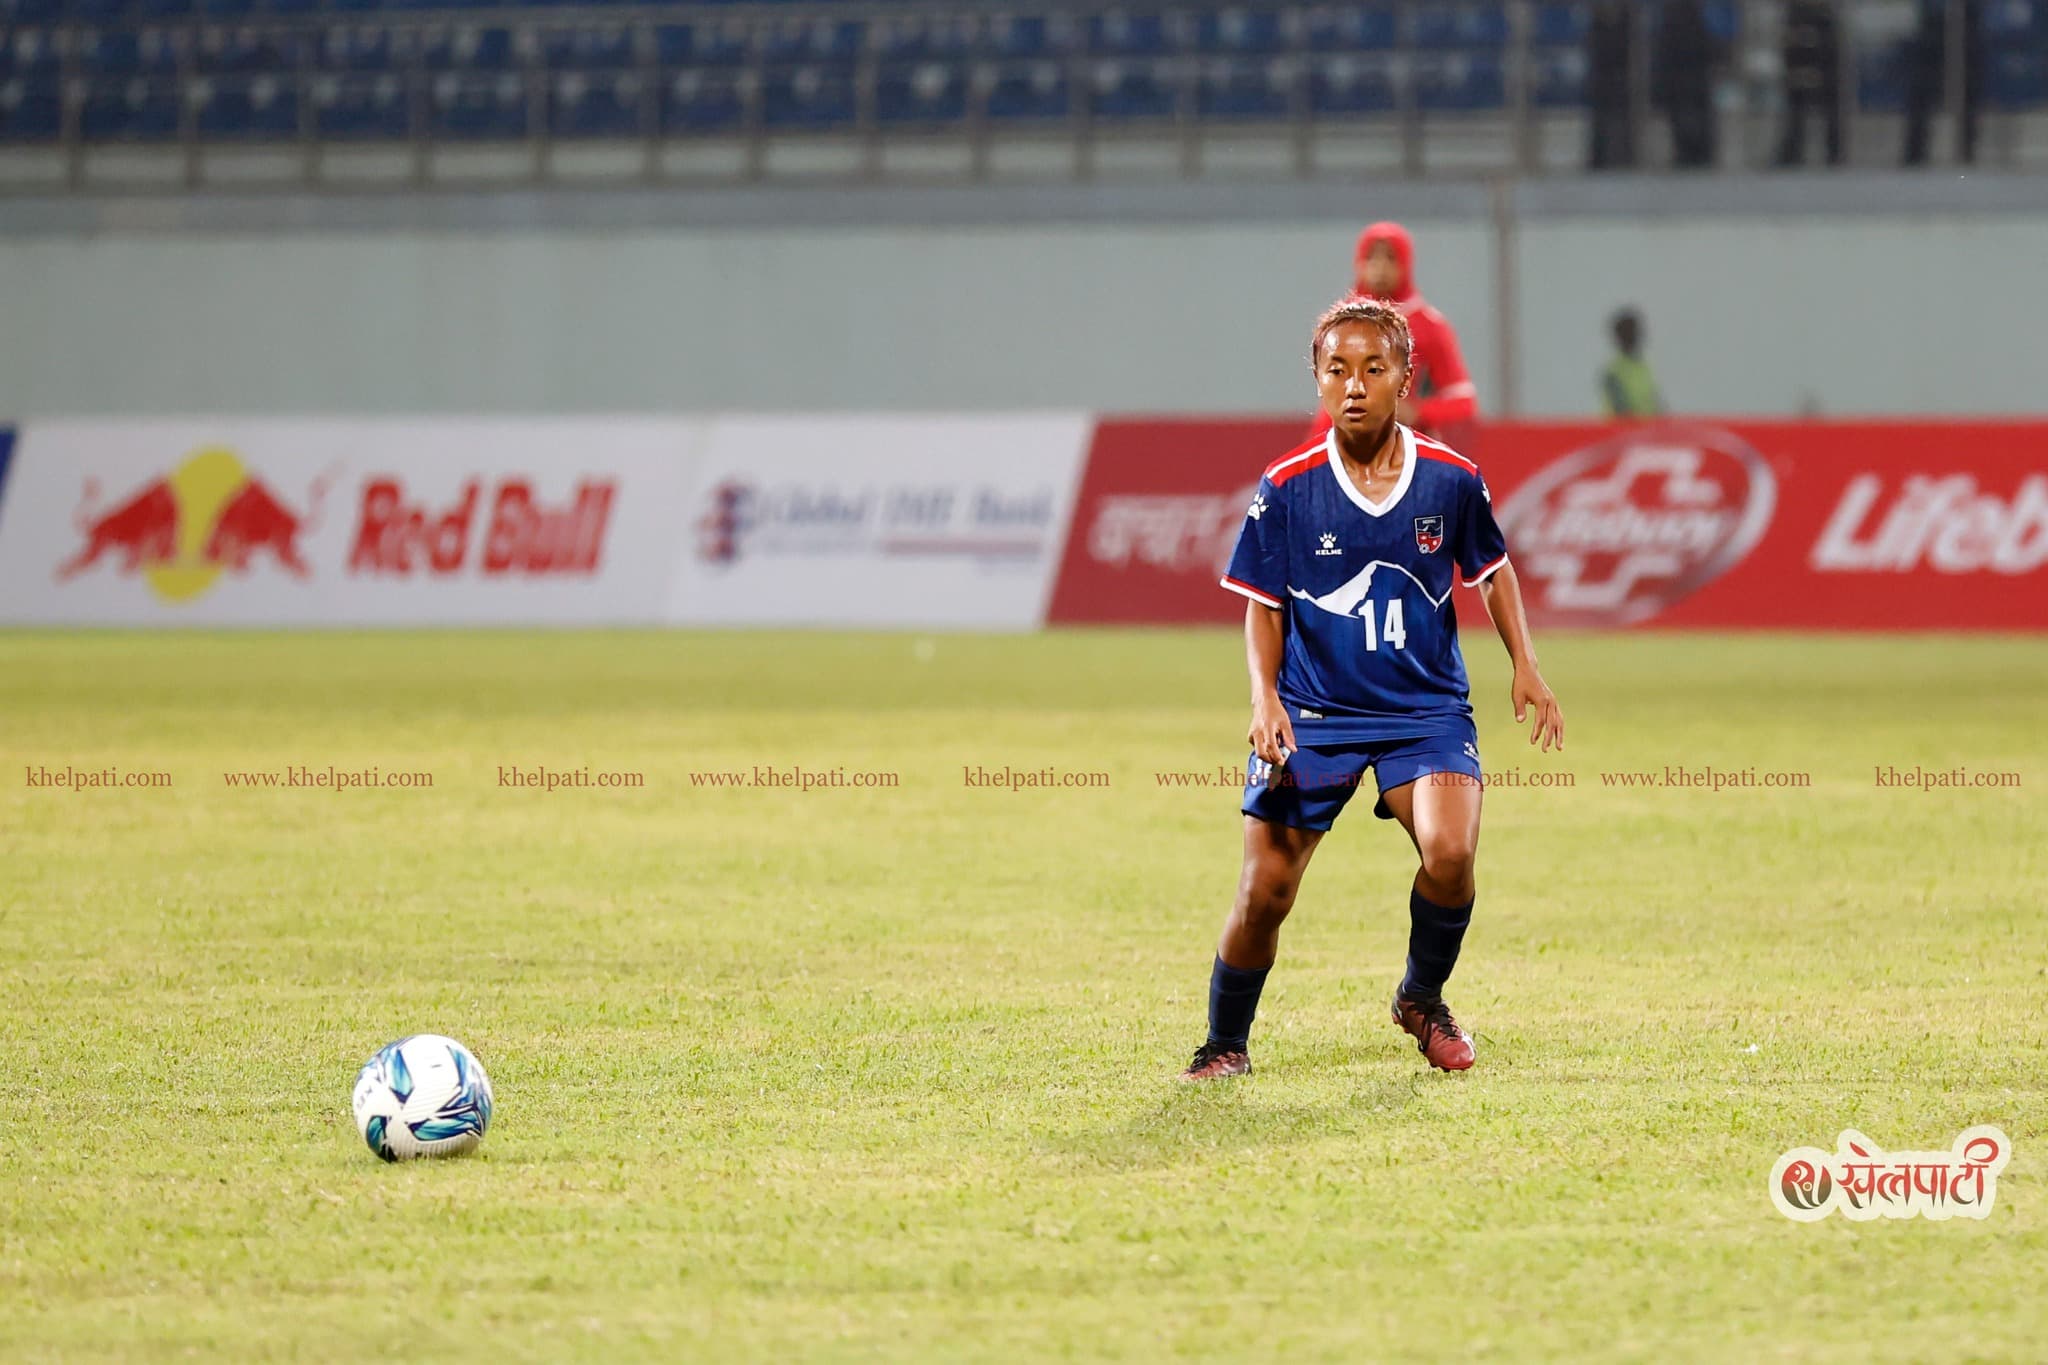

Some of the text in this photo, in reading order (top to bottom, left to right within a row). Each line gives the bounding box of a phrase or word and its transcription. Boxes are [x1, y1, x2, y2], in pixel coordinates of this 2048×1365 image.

[348, 474, 618, 577] Red Bull
[1315, 548, 1342, 556] KELME
[1358, 598, 1406, 651] 14
